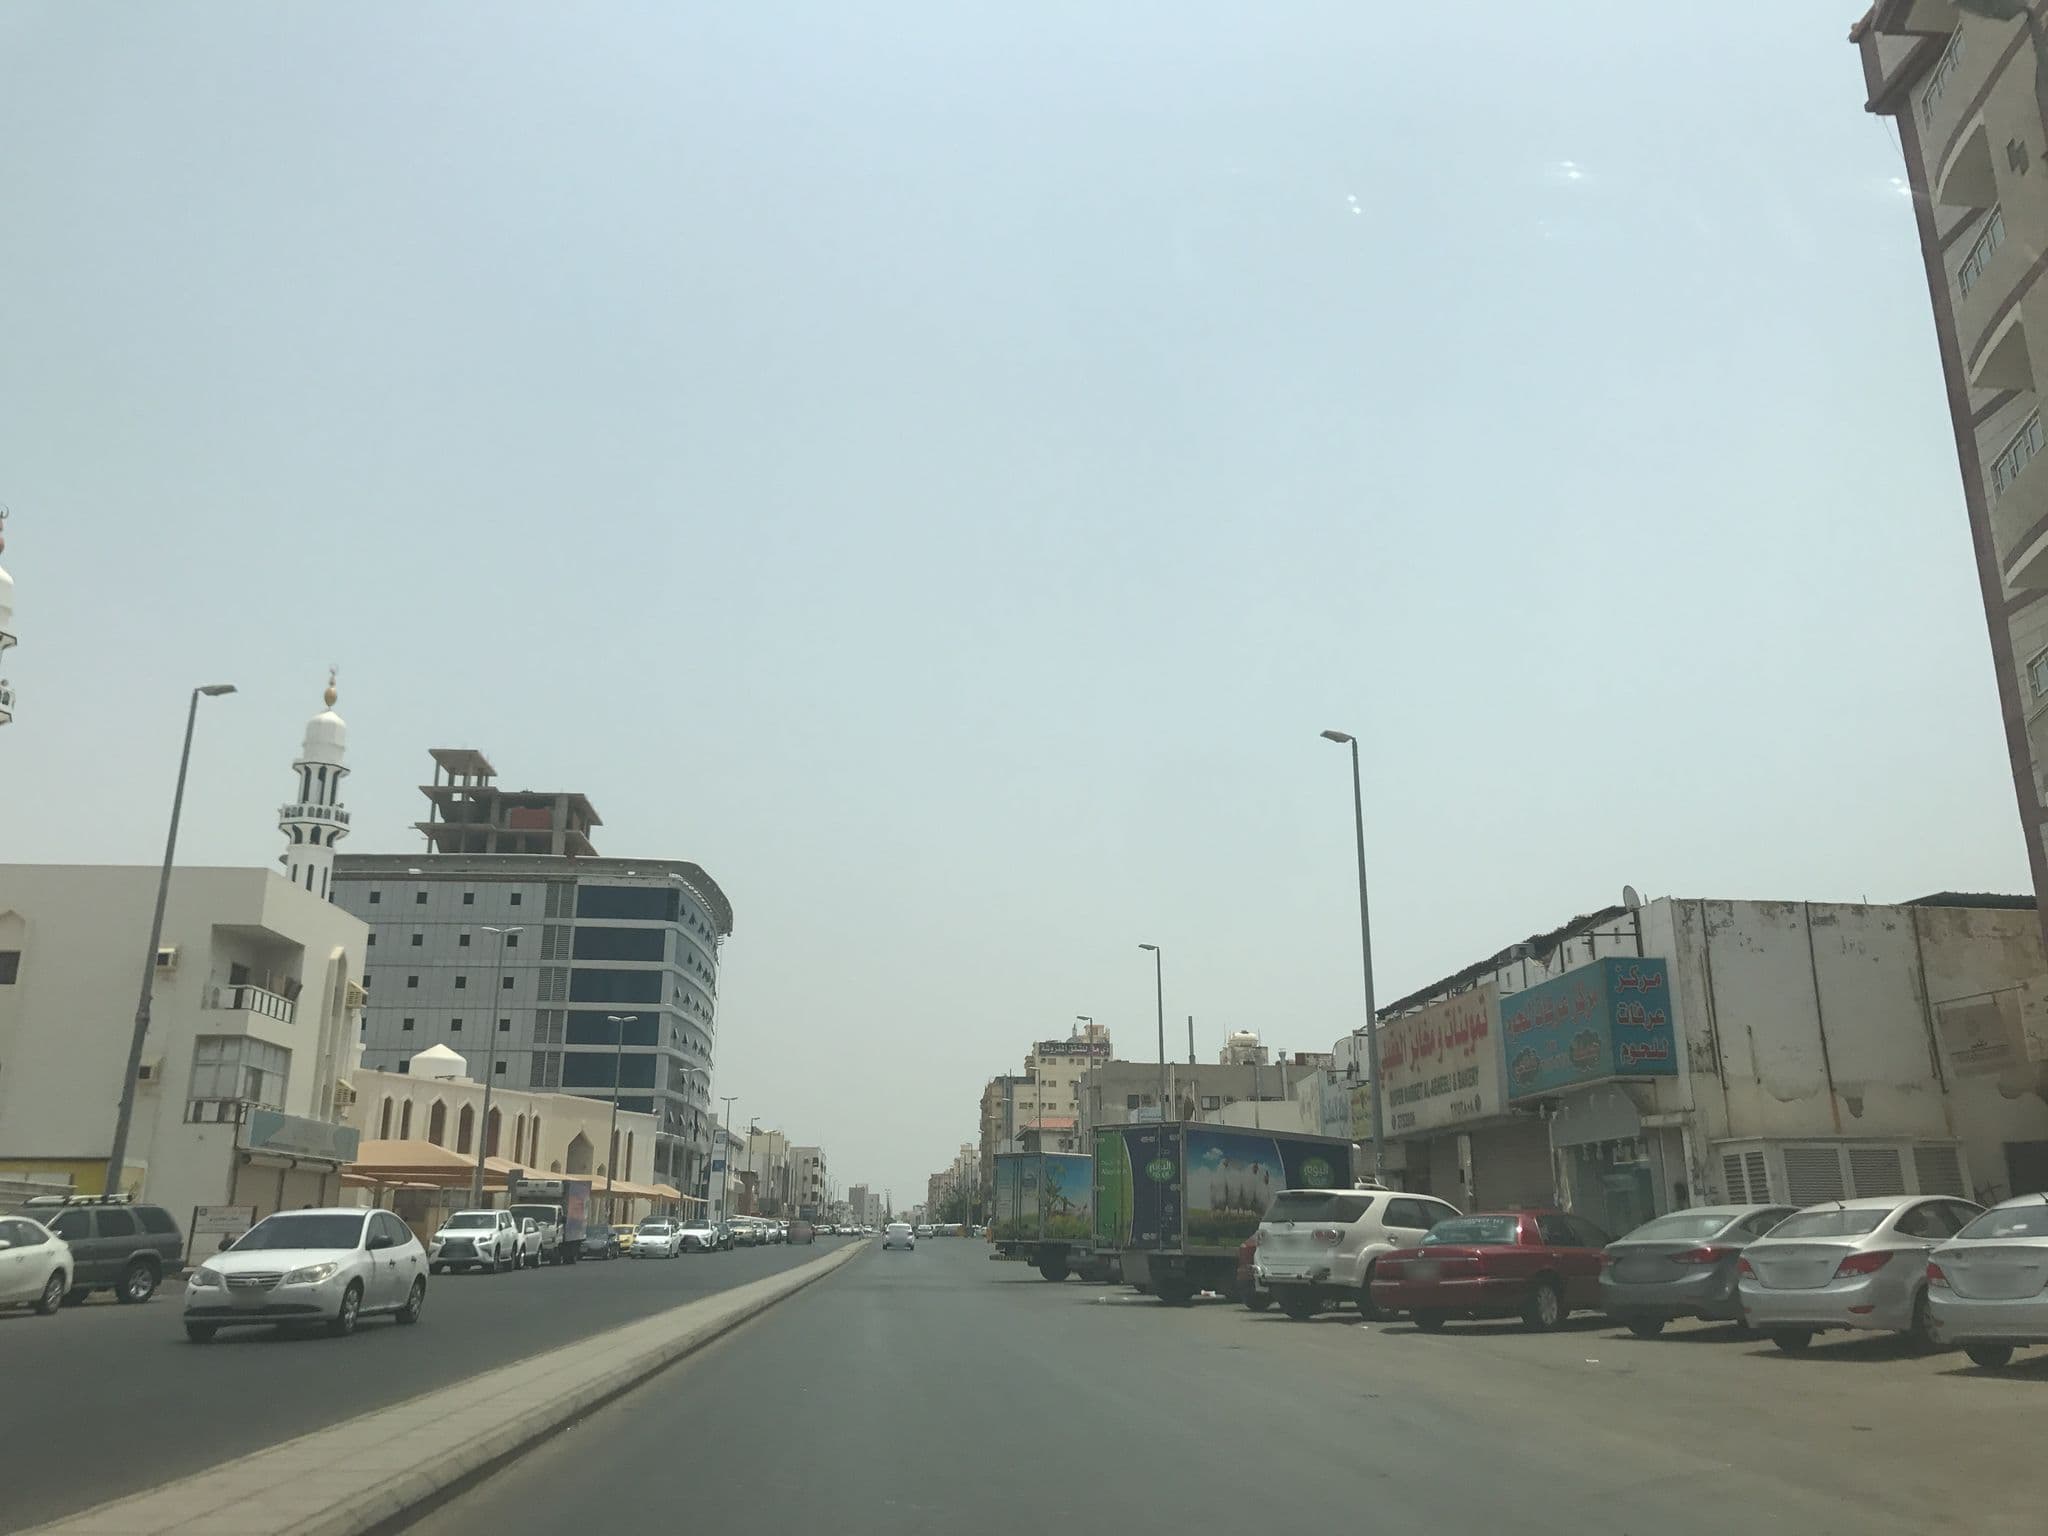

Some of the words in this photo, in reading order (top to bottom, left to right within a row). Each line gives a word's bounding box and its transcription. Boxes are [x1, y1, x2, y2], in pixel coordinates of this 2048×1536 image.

[1615, 965, 1663, 993] مركز
[1616, 1001, 1666, 1031] عرفات
[1620, 1039, 1669, 1065] للحوم
